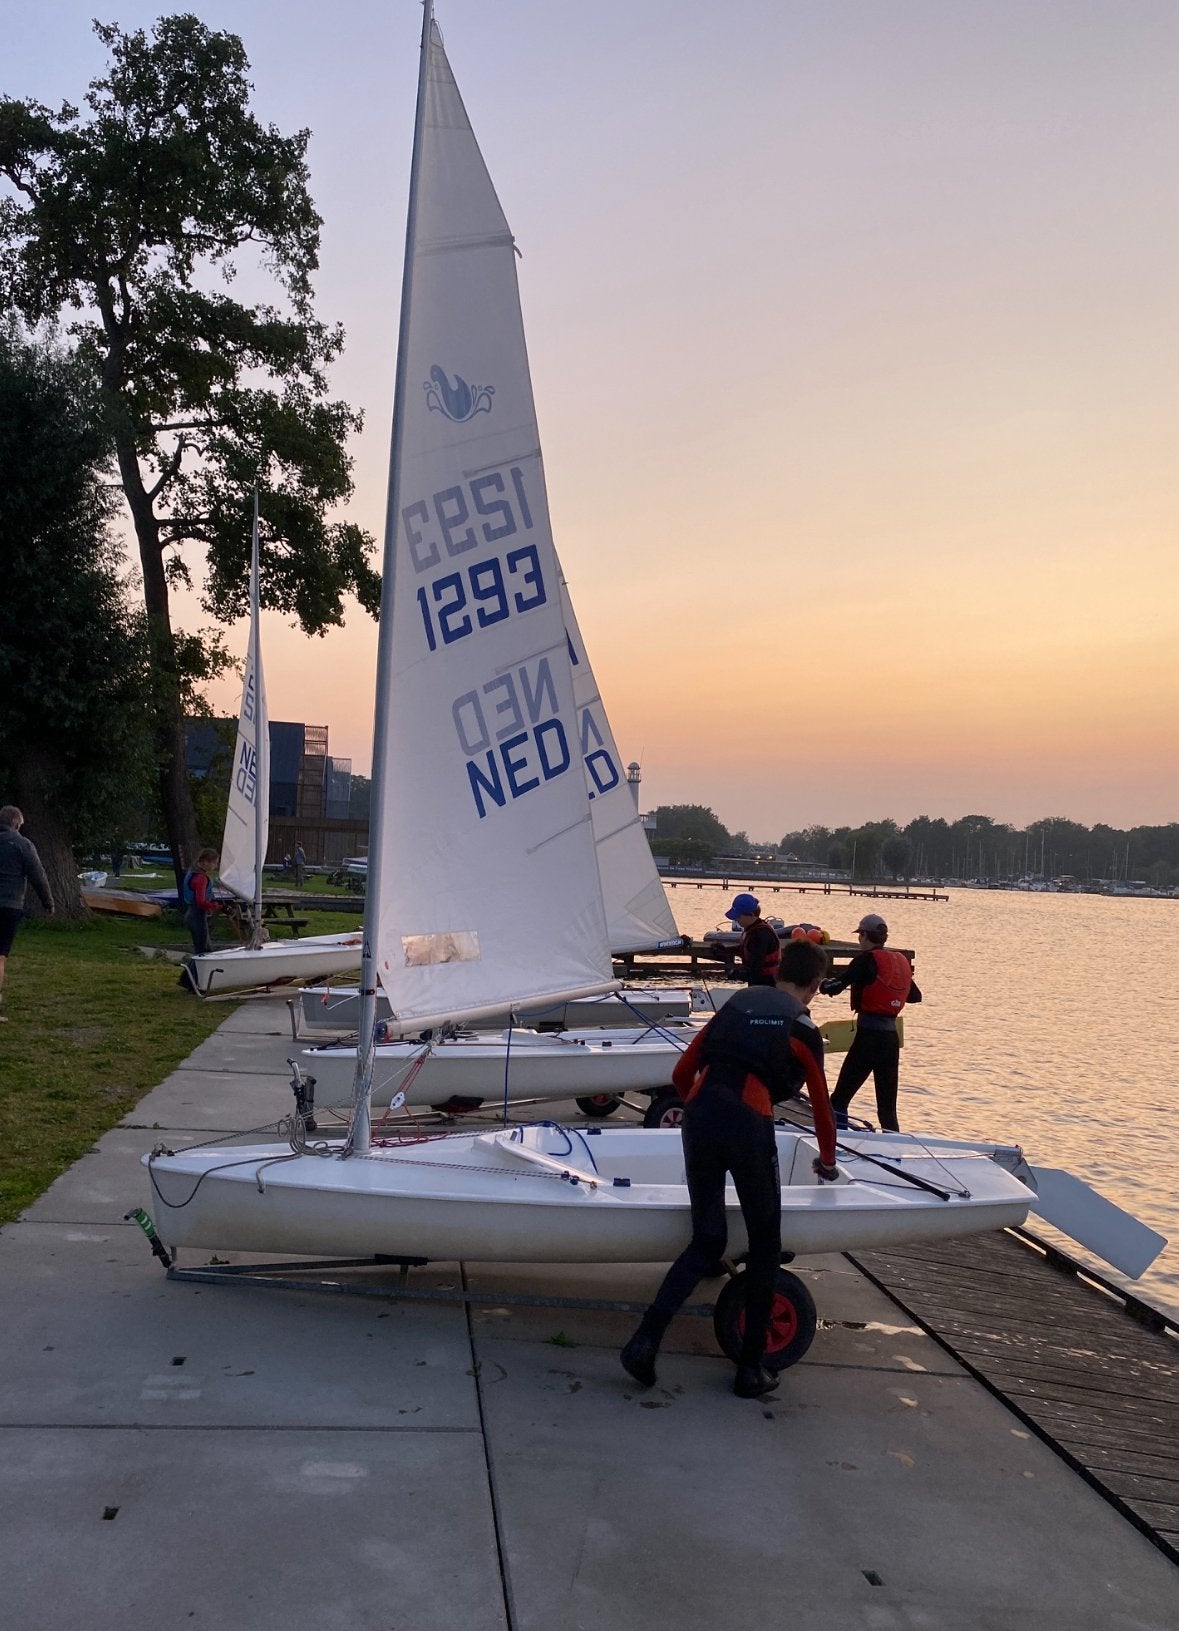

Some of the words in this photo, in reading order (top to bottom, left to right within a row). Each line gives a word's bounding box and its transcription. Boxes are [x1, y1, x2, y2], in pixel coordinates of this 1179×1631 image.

[417, 544, 547, 651] 1293
[466, 717, 571, 818] NED
[749, 1019, 785, 1027] PROLIMIT
